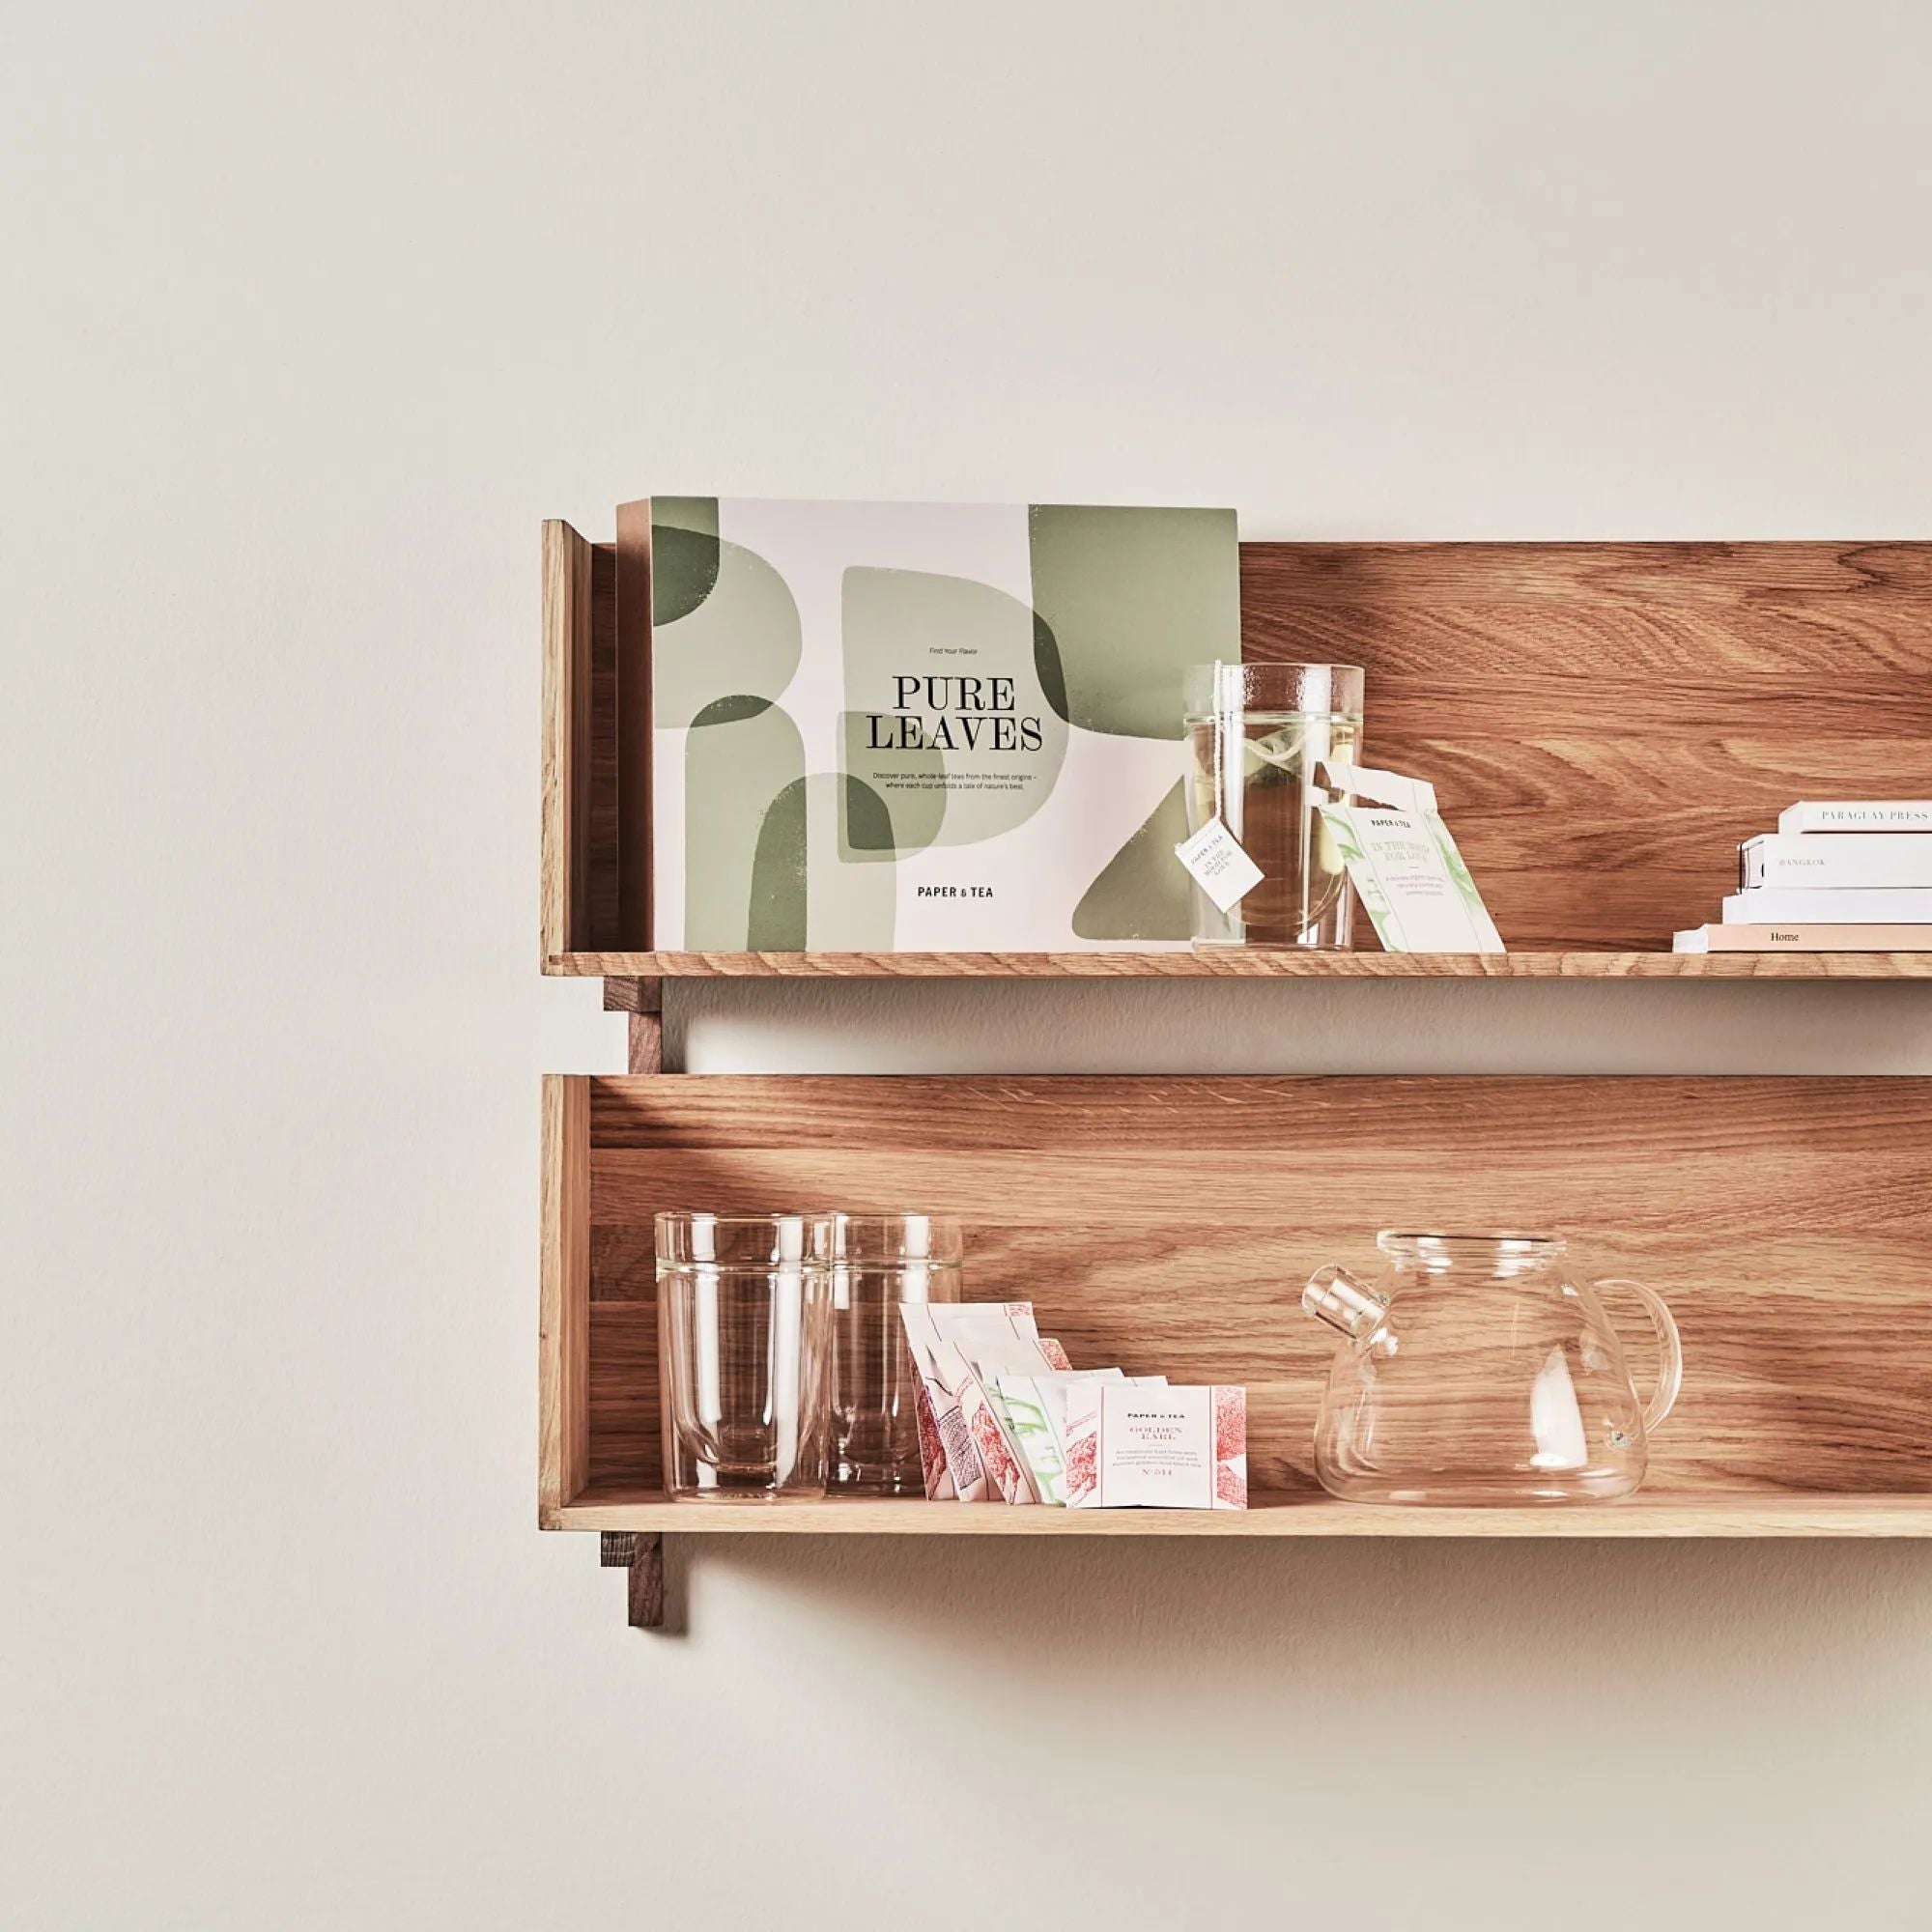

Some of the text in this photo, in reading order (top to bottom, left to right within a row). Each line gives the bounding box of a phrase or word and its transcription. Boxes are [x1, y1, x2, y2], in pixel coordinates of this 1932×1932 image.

[892, 675, 1015, 711] PURE
[866, 715, 1043, 752] LEAVES
[1822, 810, 1928, 820] PARAGUAY PRESS
[917, 886, 957, 897] PAPER
[970, 886, 993, 897] TEA
[1771, 932, 1800, 942] Home
